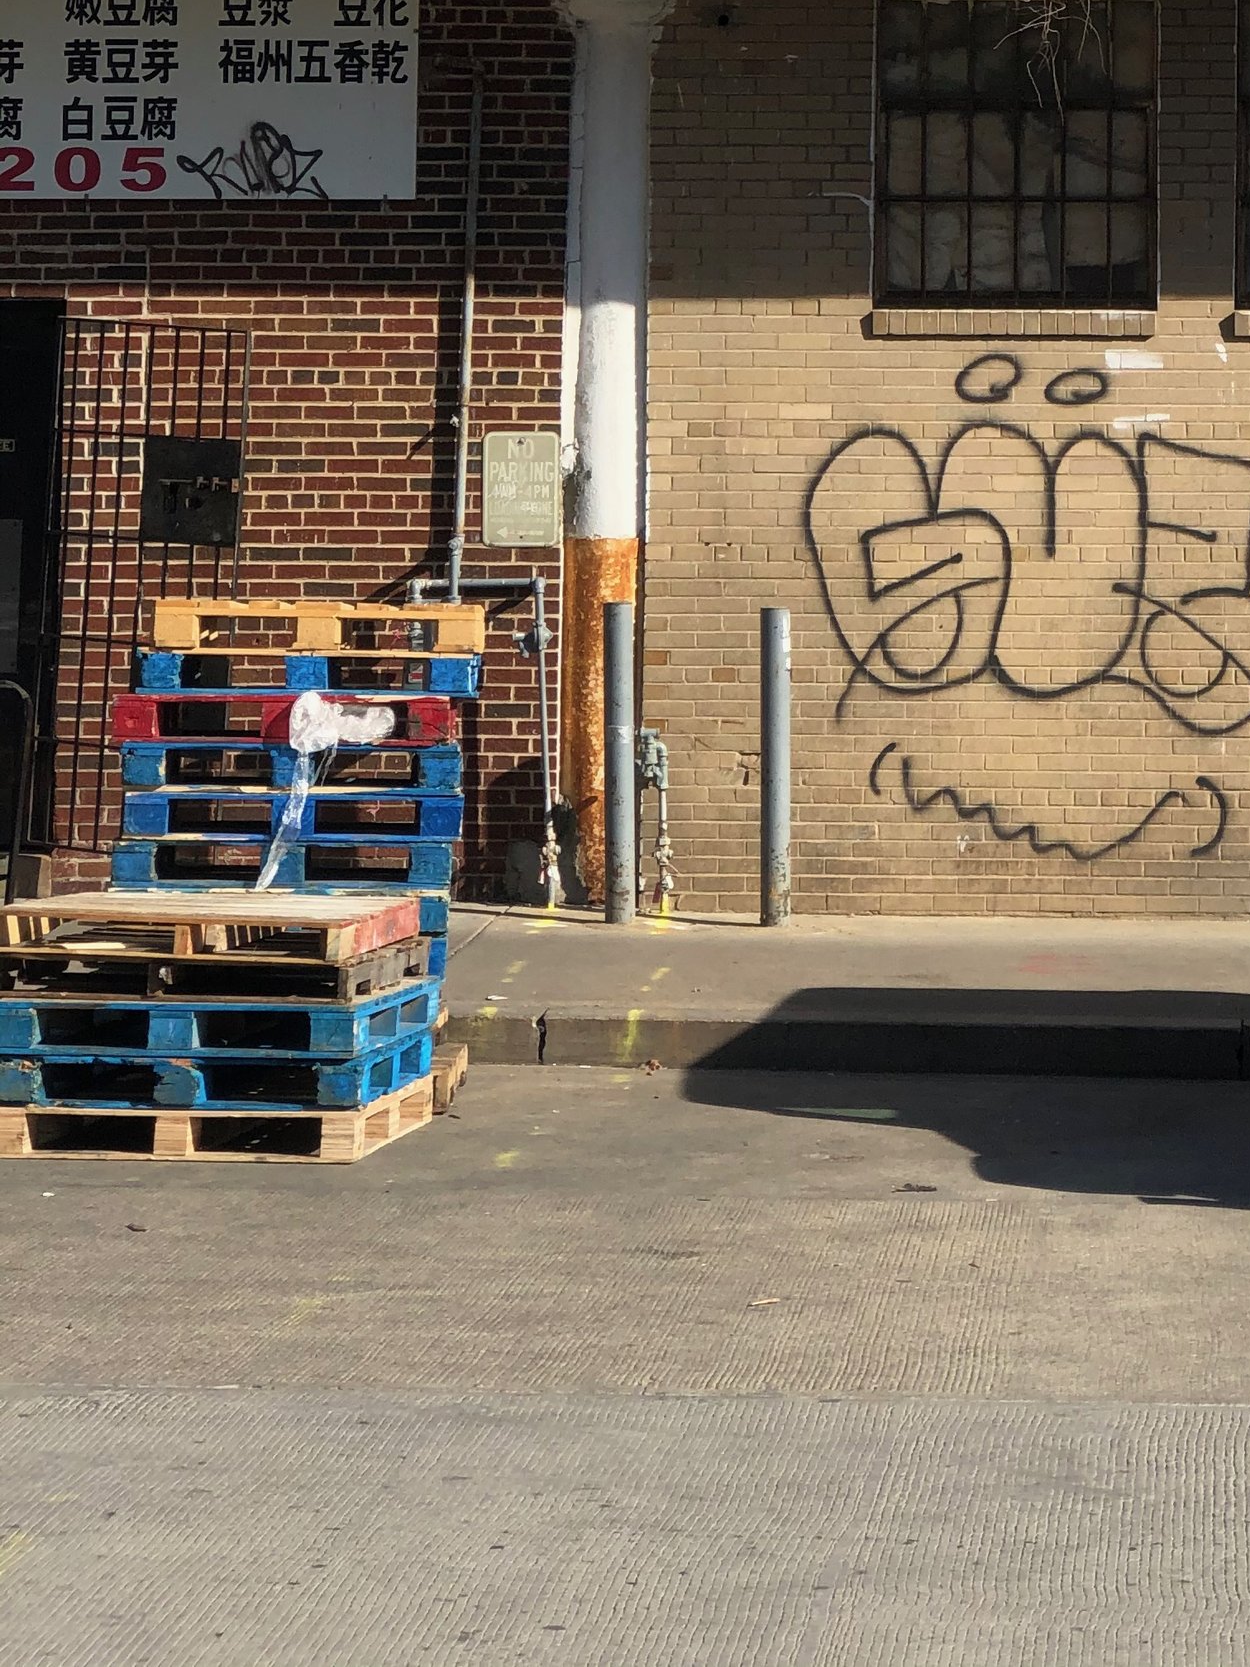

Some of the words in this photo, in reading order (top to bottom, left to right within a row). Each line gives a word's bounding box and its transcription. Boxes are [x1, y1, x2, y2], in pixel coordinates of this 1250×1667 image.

[218, 39, 409, 84] 福州五香乾
[62, 96, 177, 141] 白豆腐
[507, 438, 535, 459] NO
[489, 461, 555, 482] PARKING
